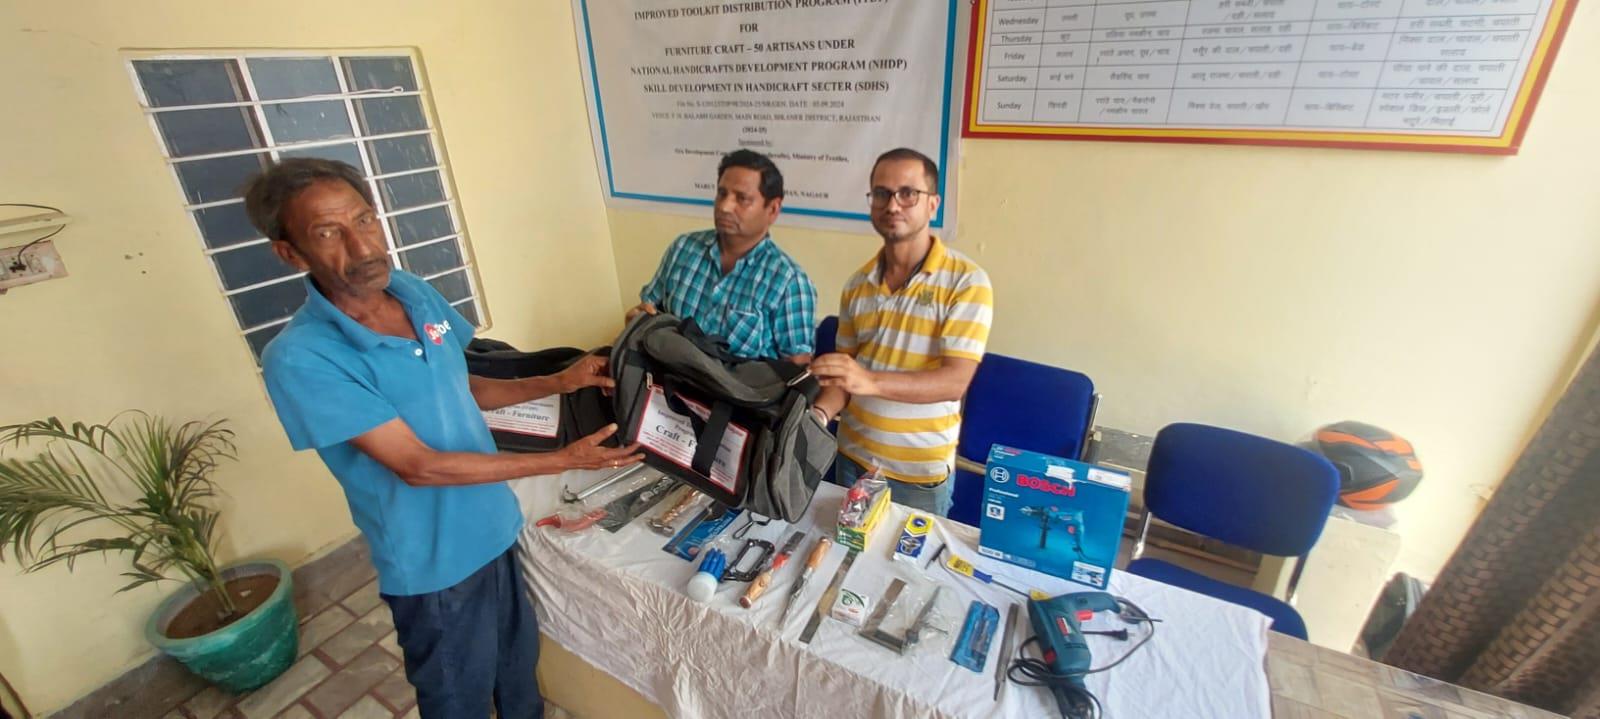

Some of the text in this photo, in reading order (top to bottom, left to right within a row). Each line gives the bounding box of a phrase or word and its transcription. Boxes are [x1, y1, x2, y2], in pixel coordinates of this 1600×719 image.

[634, 8, 679, 20] IMPROVED
[681, 5, 720, 17] TOOLKIT
[722, 0, 792, 14] DISTRIBUTION
[999, 17, 1040, 26] Wednesday
[739, 23, 758, 33] FOR
[1001, 35, 1033, 44] Thursday
[665, 45, 712, 57] FURNITURE
[714, 44, 744, 55] CRAFT
[753, 43, 764, 53] 50
[766, 41, 815, 52] ARTISANS
[818, 39, 856, 50] UNDER
[1004, 52, 1026, 61] Friday
[631, 58, 907, 76] NATIONAL HANDICRAFTS DEVELOPMENT PROGRAM (NHDP)
[998, 74, 1028, 83] Saturday
[643, 80, 889, 93] SKILL DEVELOPMENT IN HANDICRAFT SECTER (SDHS)
[996, 102, 1022, 111] Sunday
[839, 115, 881, 123] RAJASTHAN
[511, 409, 551, 421] Furniture
[655, 424, 680, 441] Craft
[1015, 473, 1077, 497] BOSCH
